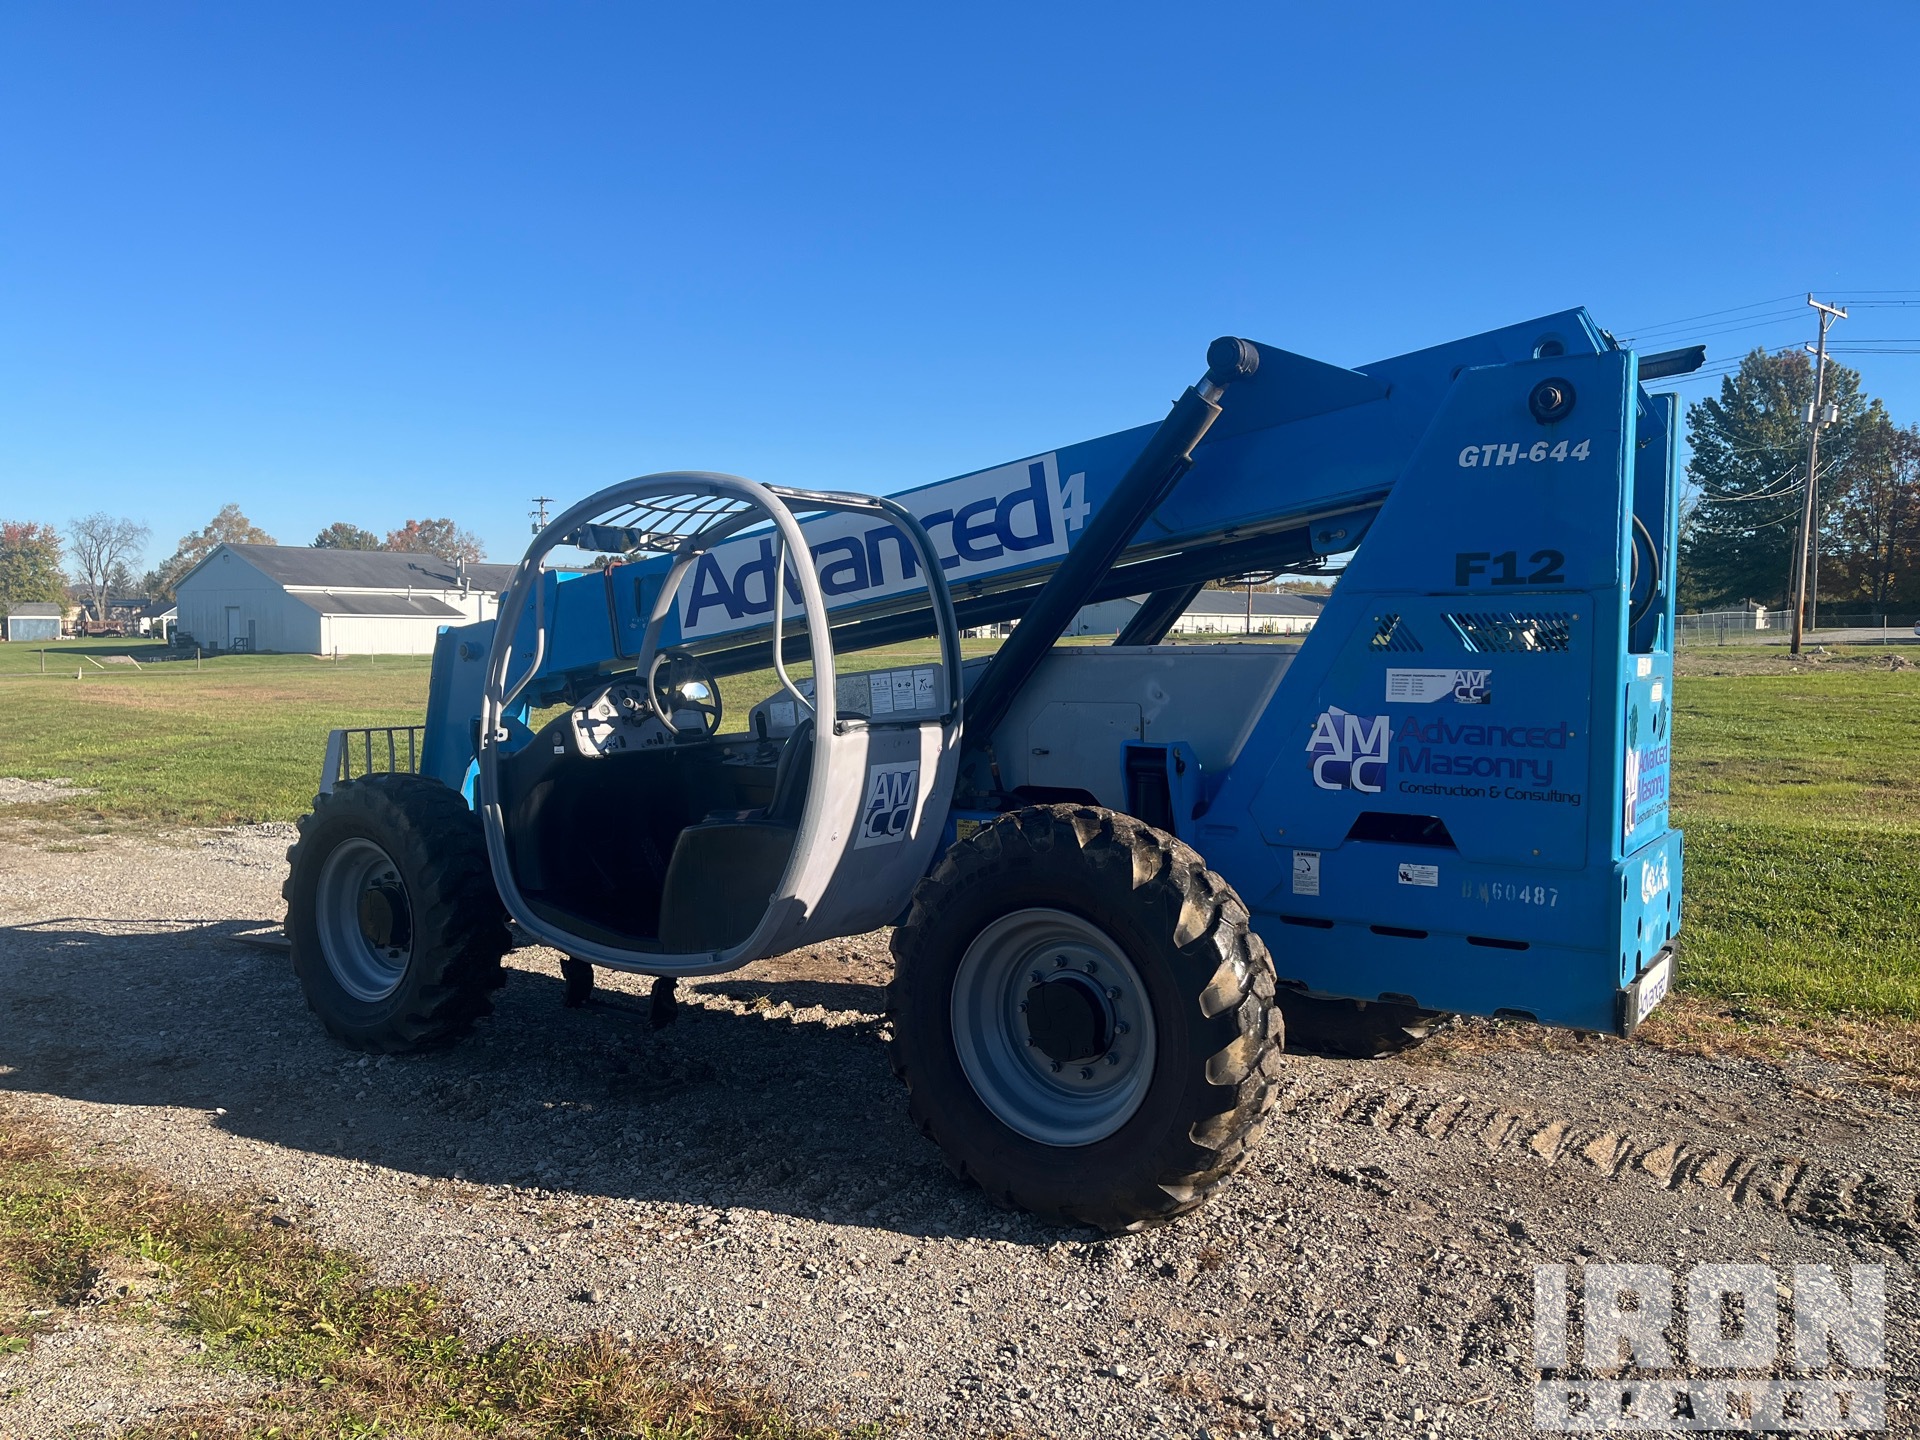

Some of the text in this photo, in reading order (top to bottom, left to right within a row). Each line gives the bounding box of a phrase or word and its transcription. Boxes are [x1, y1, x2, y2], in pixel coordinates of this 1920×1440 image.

[1458, 438, 1591, 468] GTH-644
[1455, 549, 1565, 588] F12
[1305, 712, 1390, 758] AM
[1396, 716, 1567, 750] Advanced
[1313, 754, 1389, 793] CC
[1399, 747, 1553, 787] Masonry
[1638, 738, 1668, 775] Advanced
[867, 770, 918, 809] AM
[1399, 780, 1581, 807] Construction & Consulting
[1637, 774, 1665, 806] Masonry
[866, 804, 912, 838] CC
